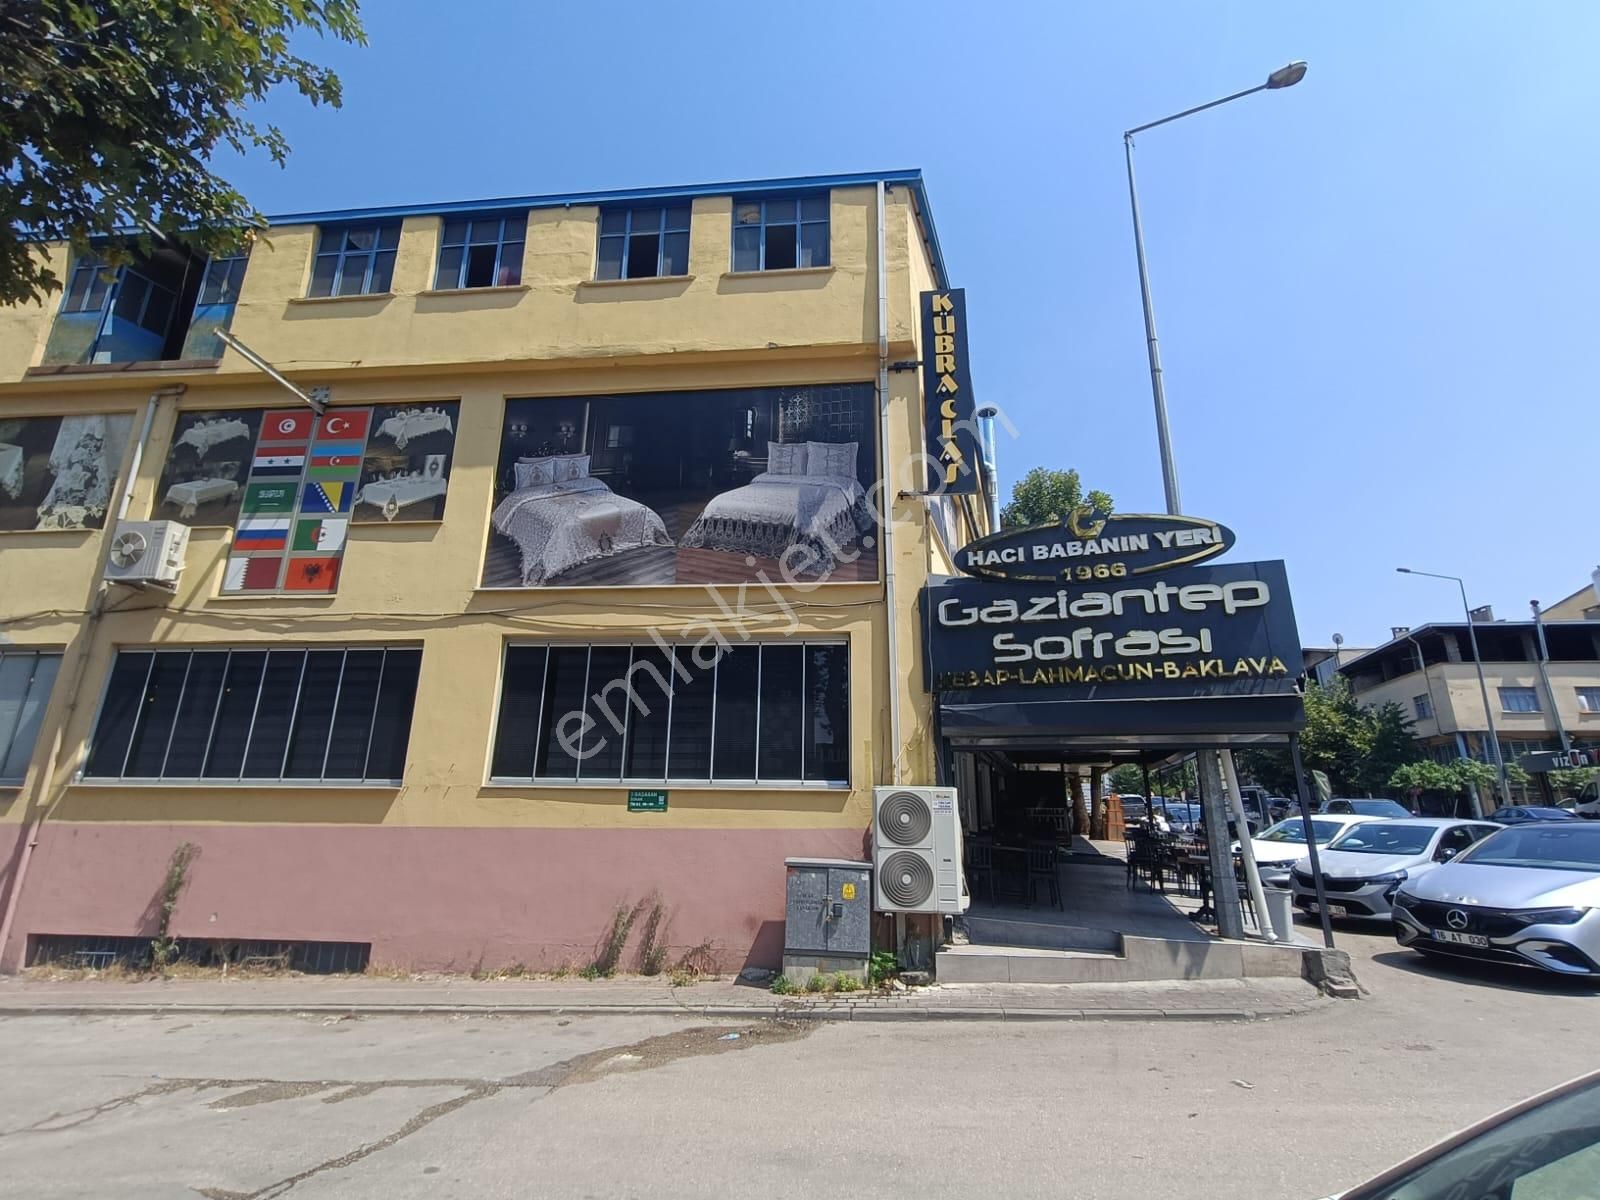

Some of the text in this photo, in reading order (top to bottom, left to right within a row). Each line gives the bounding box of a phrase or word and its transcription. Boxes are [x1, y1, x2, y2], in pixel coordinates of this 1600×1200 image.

[932, 294, 958, 394] KÜBRA
[967, 548, 1025, 567] HACI
[1033, 534, 1149, 561] BABANIN
[1061, 562, 1128, 582] 1966
[938, 580, 1270, 626] Gaziantep
